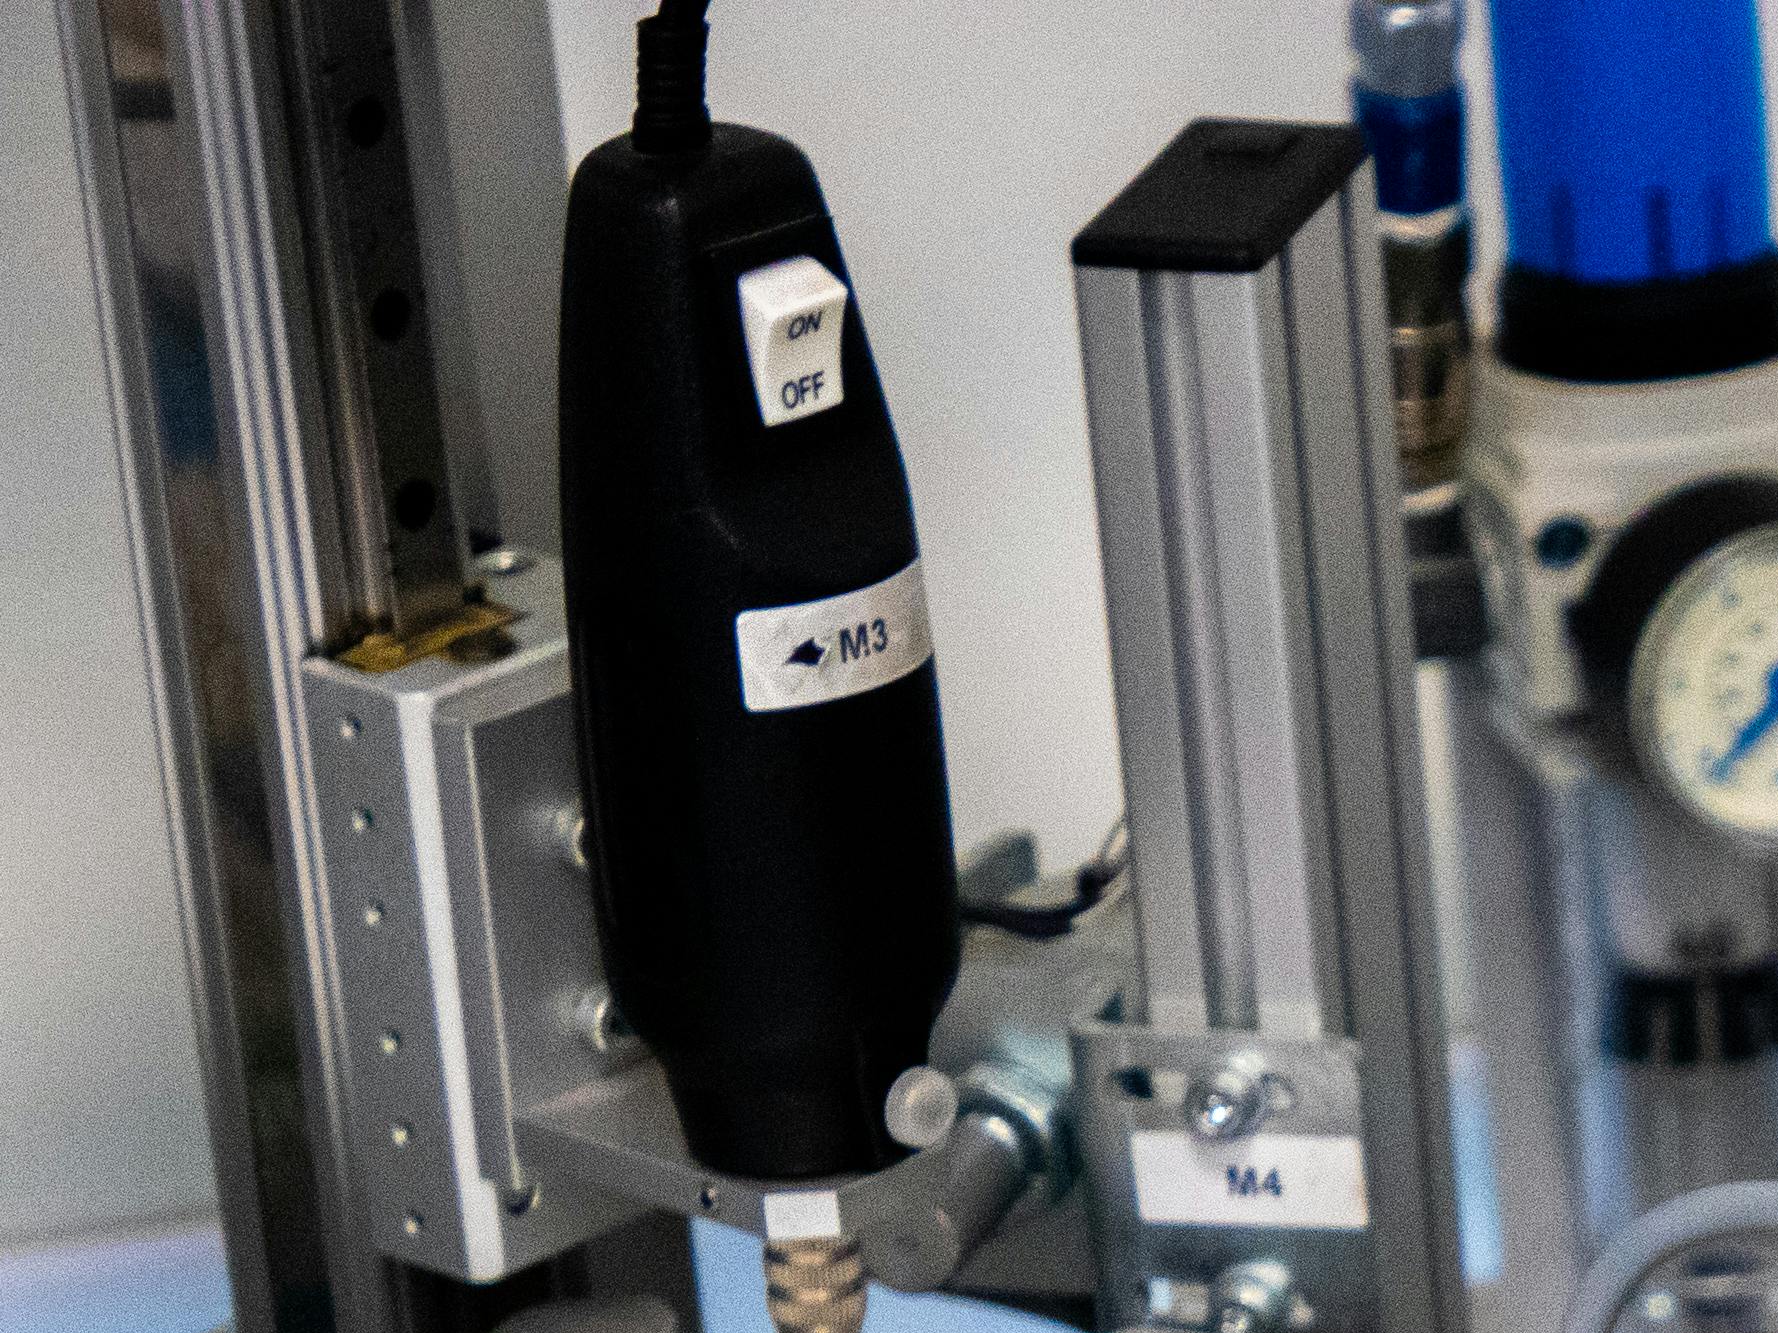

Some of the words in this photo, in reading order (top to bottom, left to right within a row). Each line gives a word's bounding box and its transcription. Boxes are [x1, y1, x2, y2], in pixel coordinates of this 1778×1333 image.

[786, 311, 824, 341] ON
[780, 371, 826, 410] OFF
[838, 618, 890, 663] M3
[1225, 1165, 1284, 1198] M4
